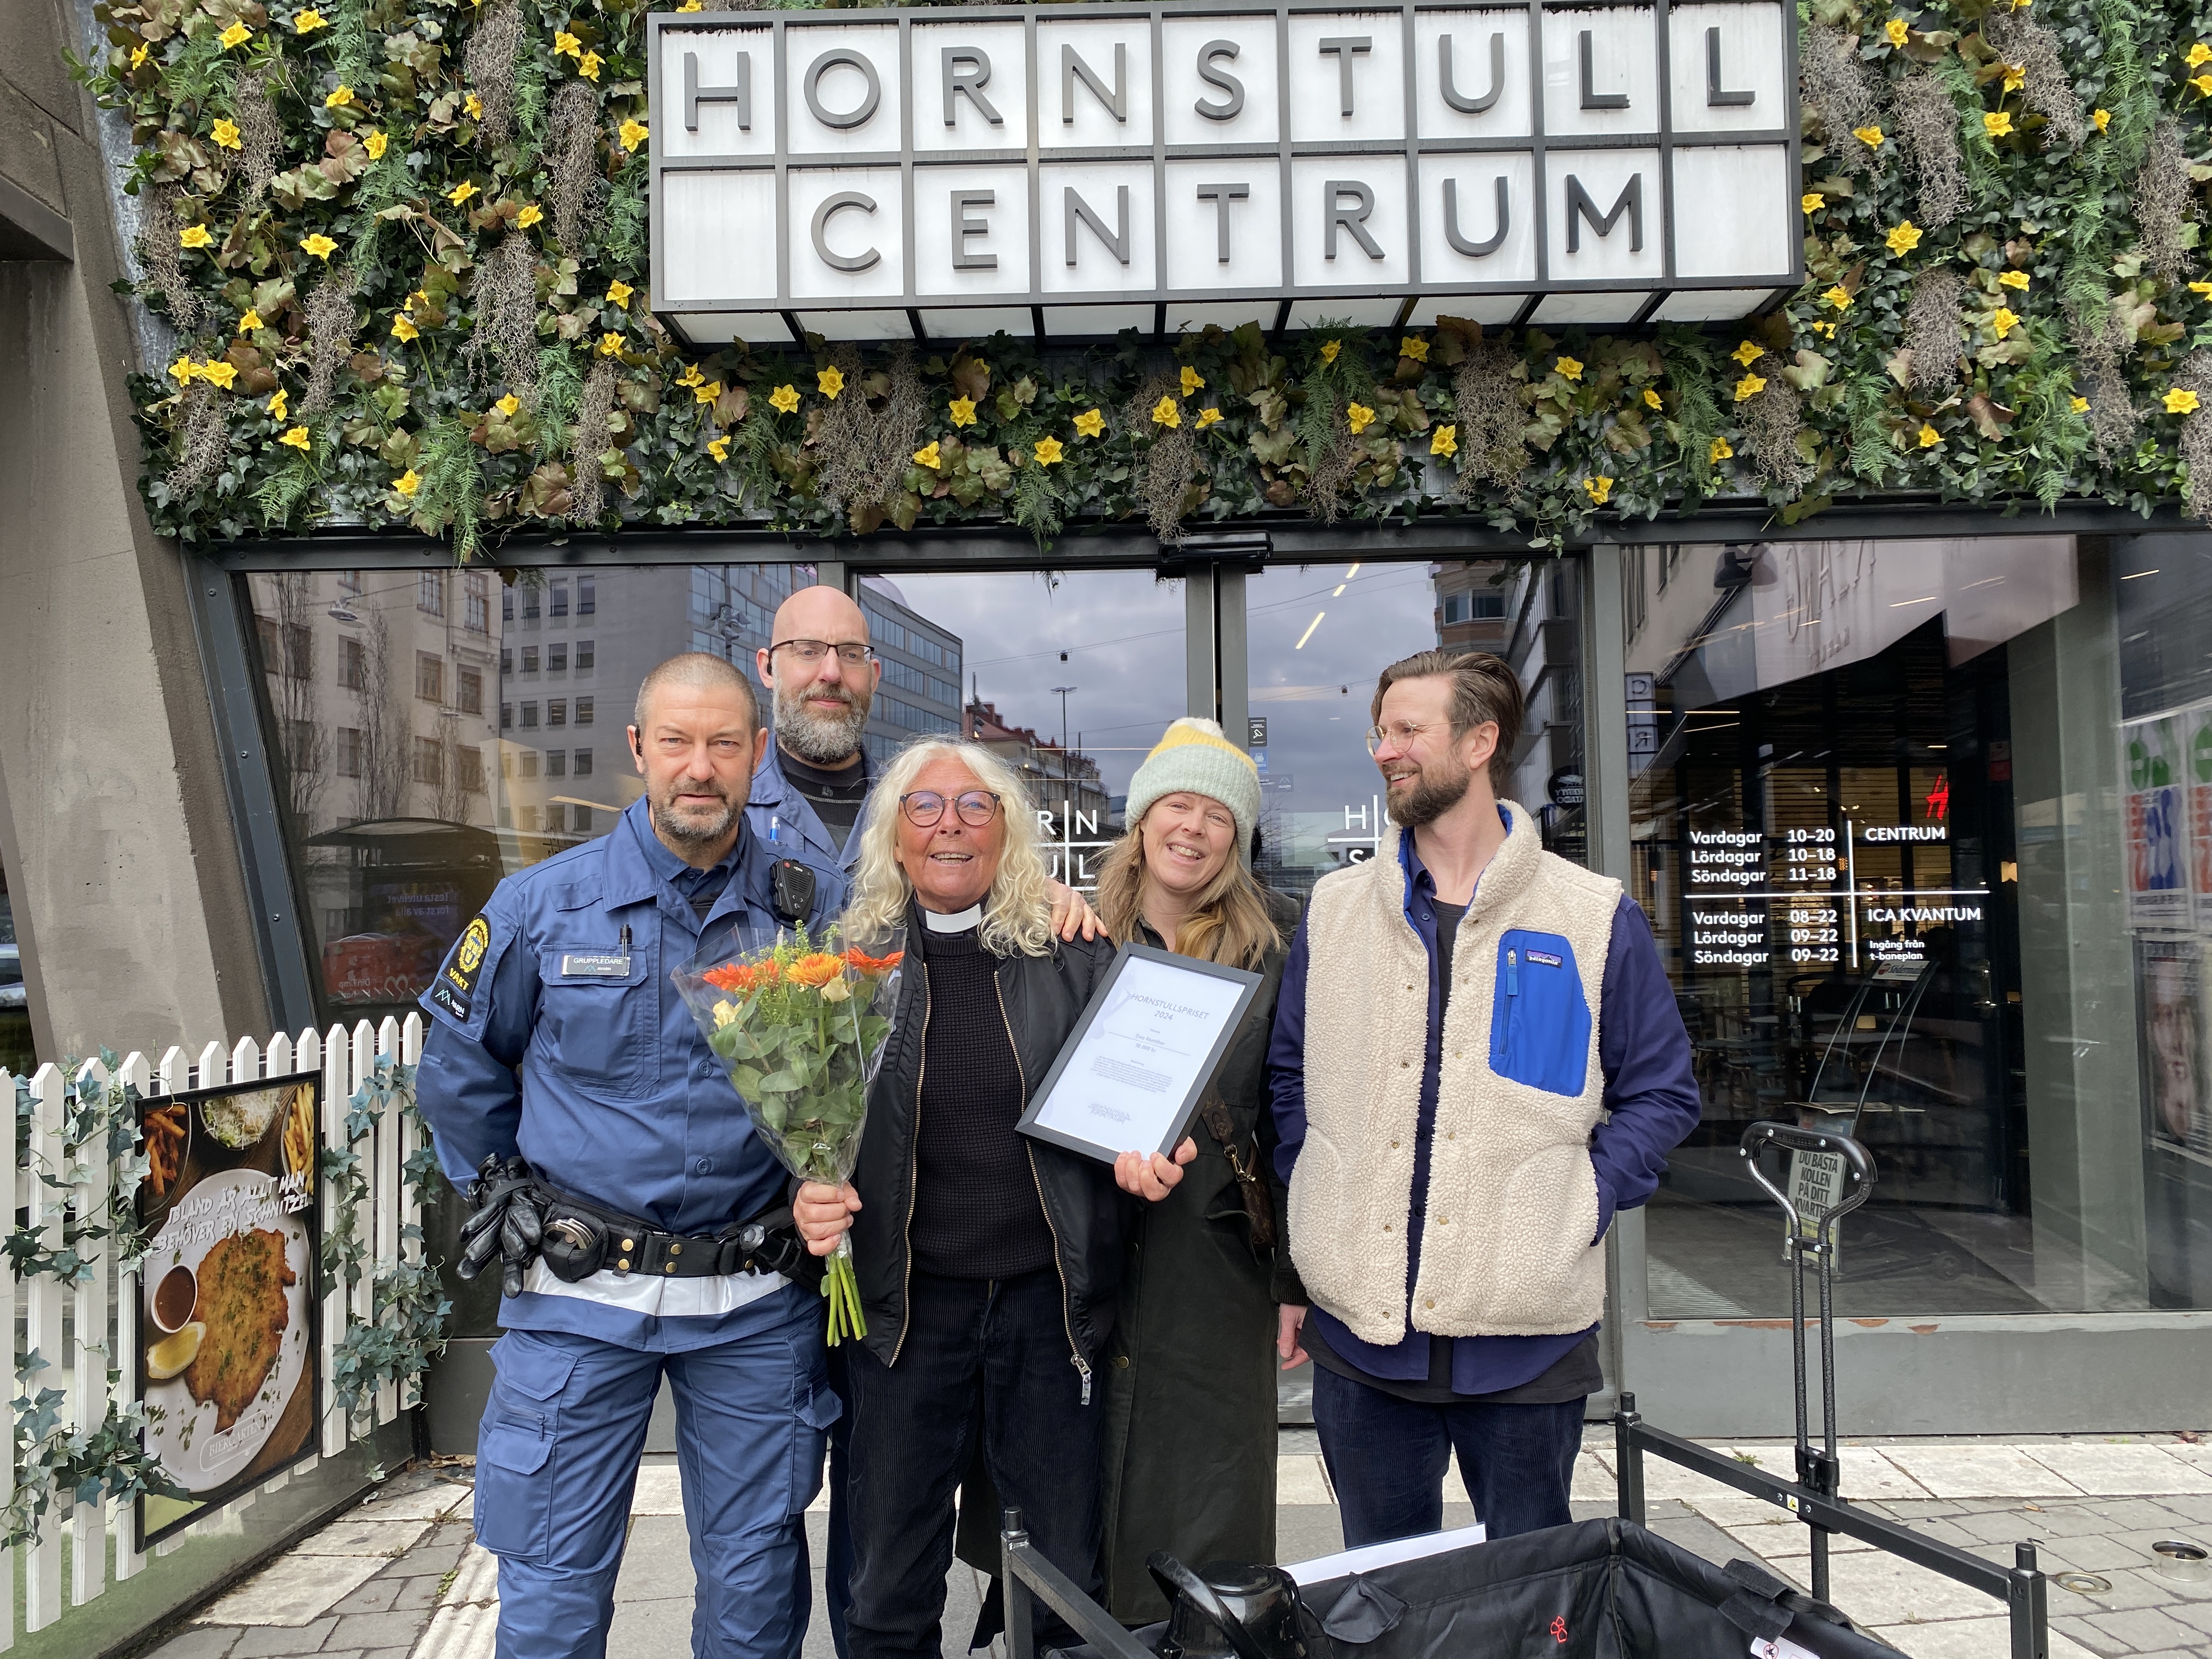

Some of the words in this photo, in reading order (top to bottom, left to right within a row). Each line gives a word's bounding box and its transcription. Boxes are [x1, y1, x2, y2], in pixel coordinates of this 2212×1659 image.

[684, 26, 1756, 131] HORNSTULL
[810, 171, 1644, 273] CENTRUM
[1690, 831, 1762, 847] Vardagar
[1865, 827, 1945, 841] CENTRUM
[1691, 850, 1761, 866] Lördagar
[1691, 869, 1766, 887] Söndagar
[1692, 911, 1765, 928] Vardagar
[1868, 908, 1896, 922] ICA
[1900, 907, 1981, 921] KVANTUM
[1694, 931, 1764, 947] Lördagar
[1870, 940, 1903, 950] Ingång
[1904, 939, 1925, 948] från
[1529, 956, 1559, 966] patagonia
[1695, 950, 1769, 966] Söndagar
[1870, 951, 1923, 962] t-baneplan
[449, 967, 469, 990] VAKT
[1131, 994, 1210, 1020] HORNSTULLSPRISET
[1154, 1010, 1174, 1020] 2024
[1801, 1167, 1831, 1188] KOLLEN
[168, 1196, 213, 1225] IBLAND
[219, 1186, 238, 1213] ÄR
[241, 1177, 278, 1206] ALLT
[278, 1170, 305, 1194] MAN
[1798, 1182, 1809, 1198] PÅ
[1810, 1187, 1830, 1203] DITT
[153, 1220, 216, 1254] BEHÖVER
[221, 1212, 239, 1234] EN
[244, 1193, 309, 1227] SCHNITZEL
[209, 1420, 261, 1457] BIERGARTEN
